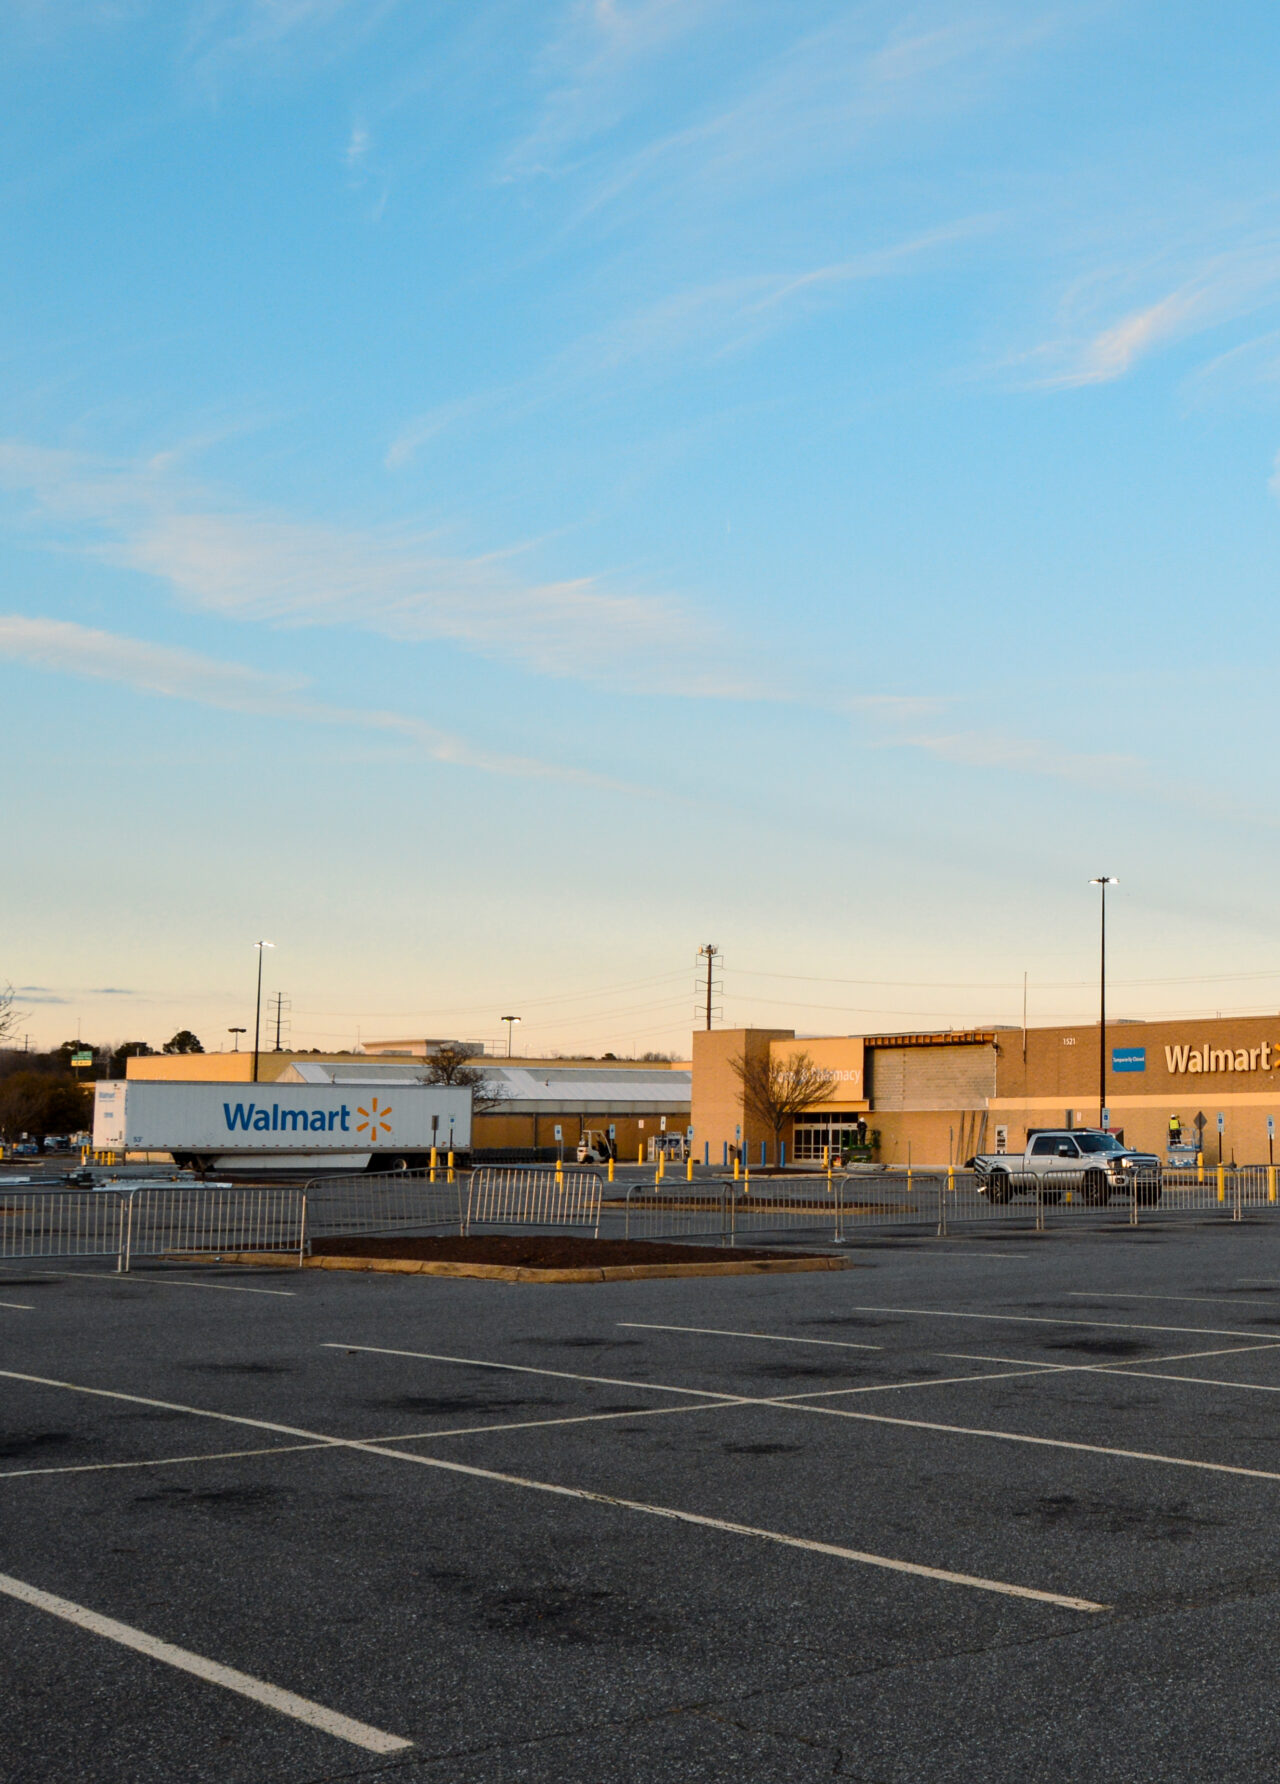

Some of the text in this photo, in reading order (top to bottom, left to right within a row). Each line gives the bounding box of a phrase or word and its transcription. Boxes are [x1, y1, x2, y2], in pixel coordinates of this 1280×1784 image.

[1063, 1037, 1076, 1046] 1521
[1164, 1041, 1272, 1074] Walmart
[223, 1103, 351, 1132] Walmart
